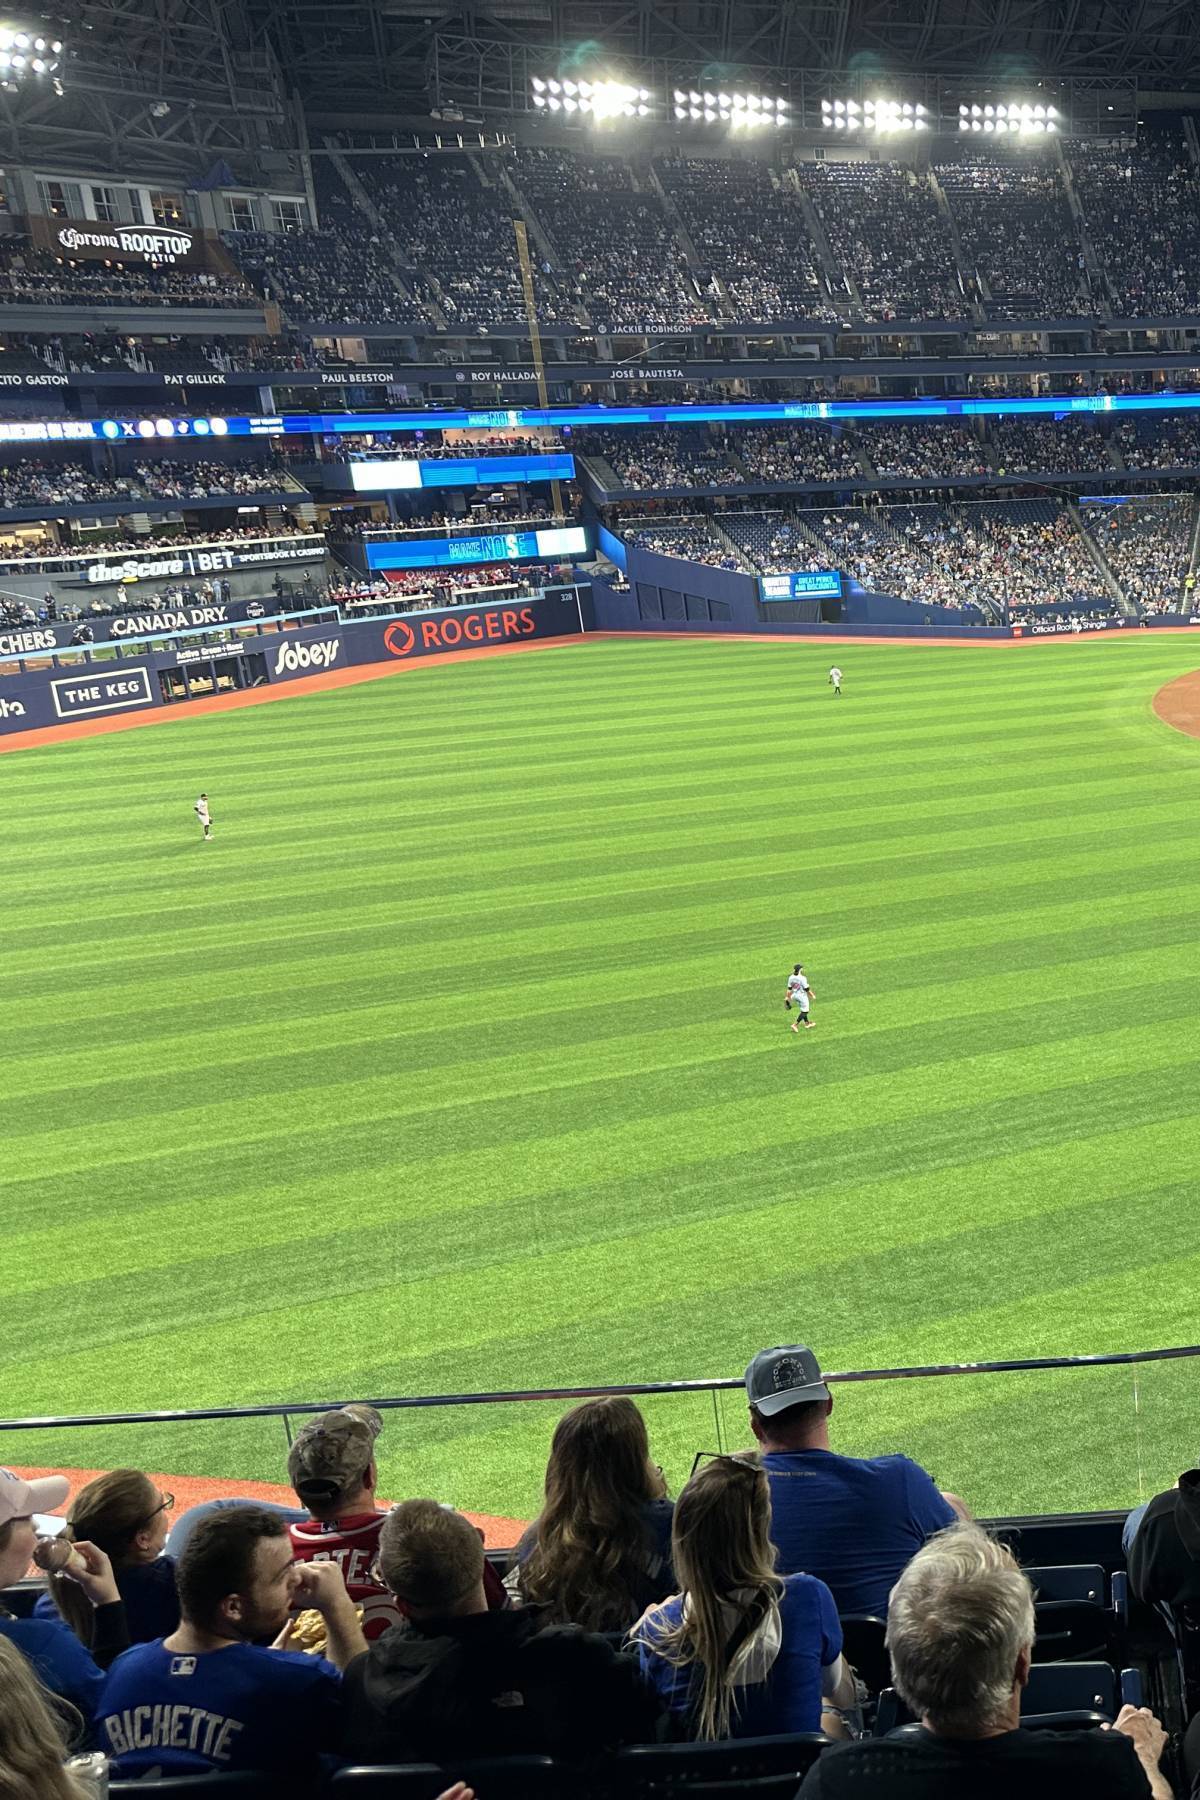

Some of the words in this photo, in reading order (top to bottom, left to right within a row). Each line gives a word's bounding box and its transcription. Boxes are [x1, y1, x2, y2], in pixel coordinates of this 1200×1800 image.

[58, 228, 119, 250] Corona
[119, 233, 192, 255] ROOFTOP
[143, 252, 176, 263] PATIO
[612, 325, 643, 334] JACKIE
[645, 325, 692, 333] ROBINSON
[25, 375, 69, 385] GASTON
[164, 375, 183, 385] PAT
[186, 375, 226, 384] GILLICK
[322, 373, 347, 383] PAUL
[349, 373, 394, 382] BEESTON
[471, 372, 491, 381] ROY
[494, 371, 541, 381] HALLADAY
[639, 369, 684, 378] BAUTISTA
[449, 541, 480, 559] MAKE
[480, 534, 526, 560] NOISE
[88, 558, 184, 583] theScore
[198, 551, 234, 571] BET
[112, 612, 190, 636] CANADA
[422, 608, 536, 648] ROGERS
[1032, 625, 1056, 634] Official
[1083, 620, 1107, 629] Shingle
[275, 639, 339, 675] Sobeys
[65, 686, 101, 703] THE
[106, 681, 140, 697] KEG
[105, 1704, 245, 1761] BICHETTE
